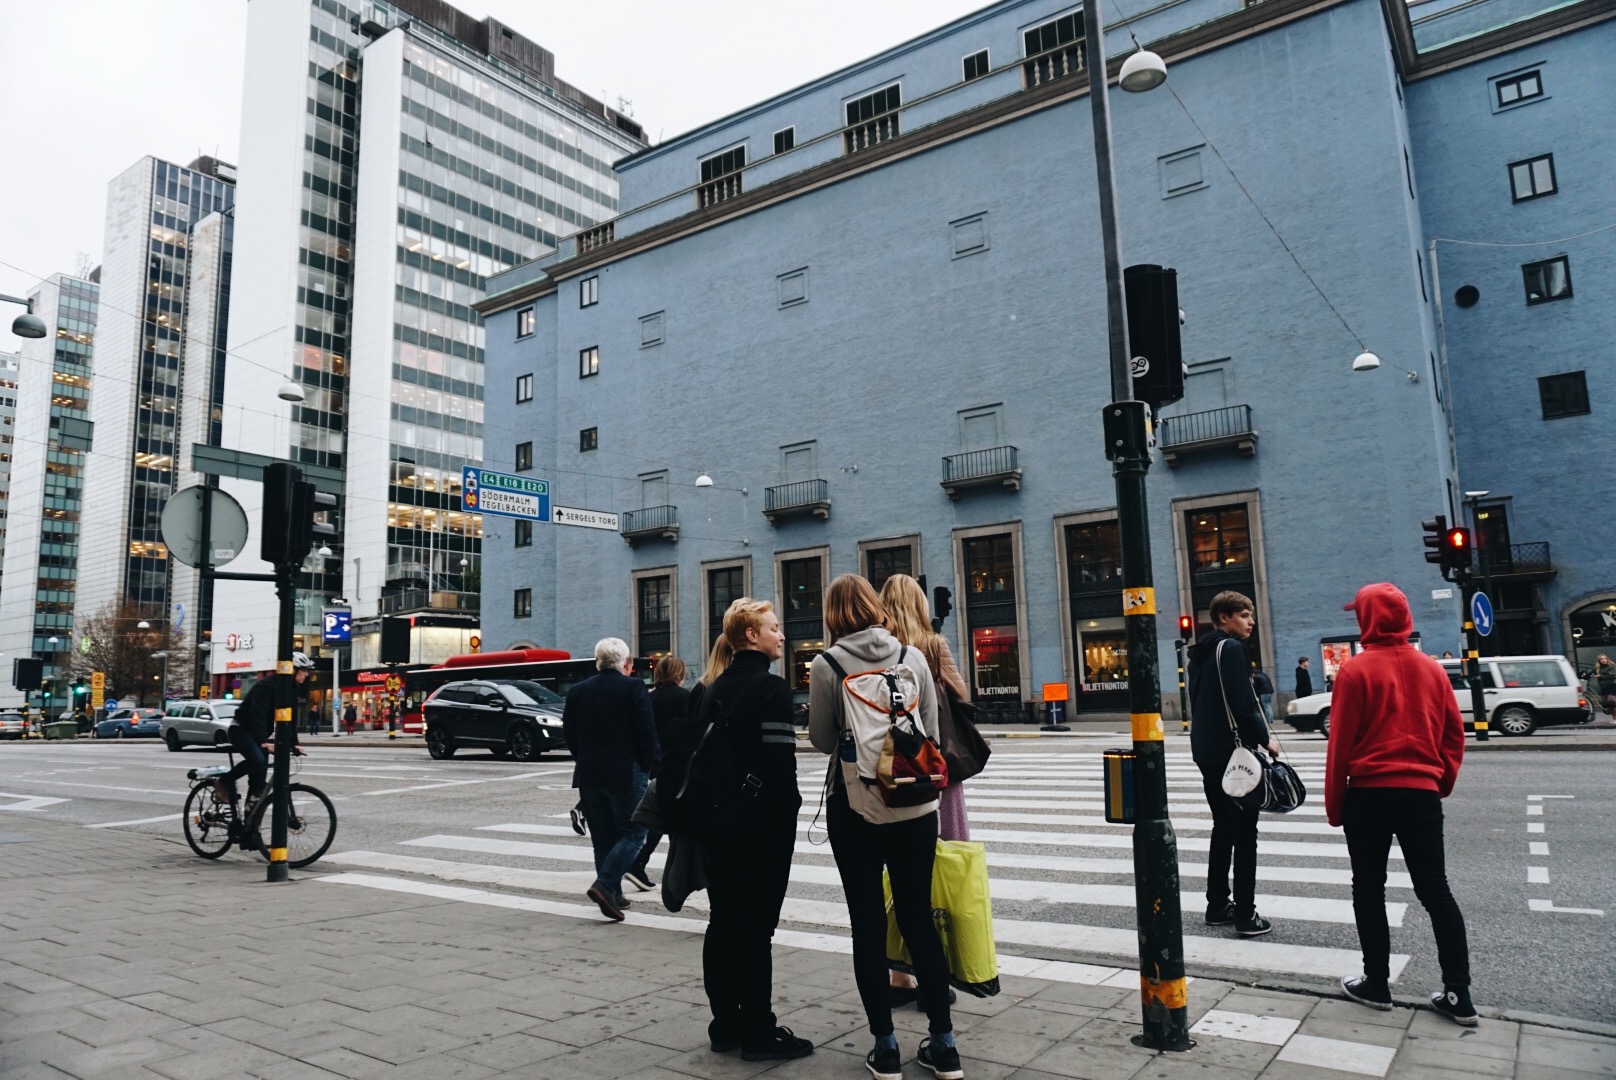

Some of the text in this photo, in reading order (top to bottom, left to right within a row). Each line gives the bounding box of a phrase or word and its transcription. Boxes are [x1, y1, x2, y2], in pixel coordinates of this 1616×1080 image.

[483, 474, 544, 492] E4 E18 E20
[481, 490, 531, 505] SÖDERMALM
[481, 500, 537, 515] TEGELBACKEN
[566, 512, 617, 526] SERGELS TORG
[325, 616, 337, 632] P
[977, 686, 1019, 696] BILJETTKONTOR
[1082, 681, 1129, 692] BILJETTKONTOR
